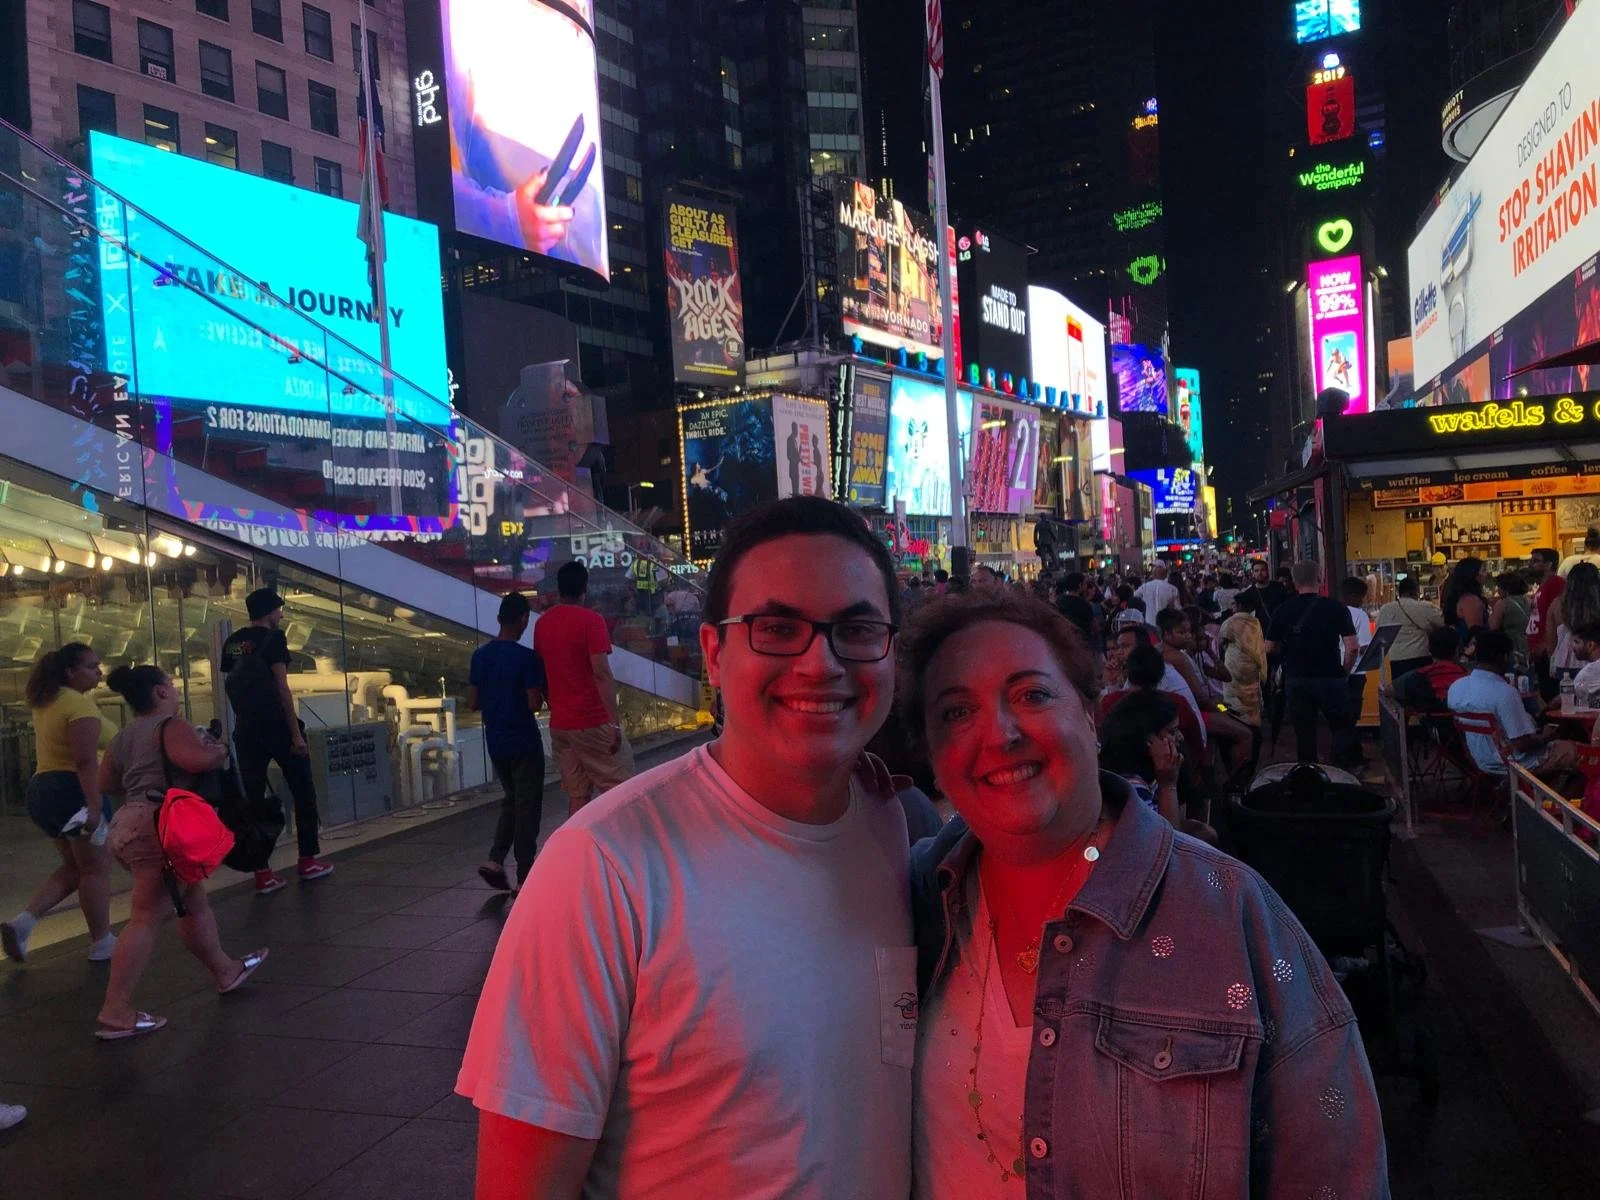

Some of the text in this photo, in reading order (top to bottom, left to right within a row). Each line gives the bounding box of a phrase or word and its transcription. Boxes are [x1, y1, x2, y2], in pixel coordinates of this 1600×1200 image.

[1314, 67, 1345, 84] 2019
[415, 70, 441, 123] ghd
[1517, 82, 1572, 168] DESIGNED TO
[1299, 161, 1364, 186] Wonderful
[1315, 163, 1331, 174] the
[669, 203, 725, 225] ABOUT AS
[669, 214, 726, 235] GUILTY AS
[840, 201, 900, 247] MARQUEE
[1499, 178, 1530, 243] STOP
[1512, 163, 1597, 278] IRRITATION
[670, 224, 733, 248] PLEASURES
[959, 250, 971, 261] LG
[288, 287, 404, 328] JOURNY
[667, 271, 742, 320] ROCK
[991, 284, 1017, 307] MADE TO
[1414, 281, 1437, 326] Gillette
[683, 309, 744, 343] AGES
[982, 294, 1026, 336] STAND OUT
[689, 418, 721, 431] DAZZLING
[1430, 401, 1546, 434] wafels
[1553, 397, 1585, 424] &
[685, 430, 707, 440] THRILL
[1388, 476, 1431, 488] waffles
[1454, 473, 1471, 482] ice
[1472, 471, 1509, 481] cream
[1530, 464, 1568, 476] coffee
